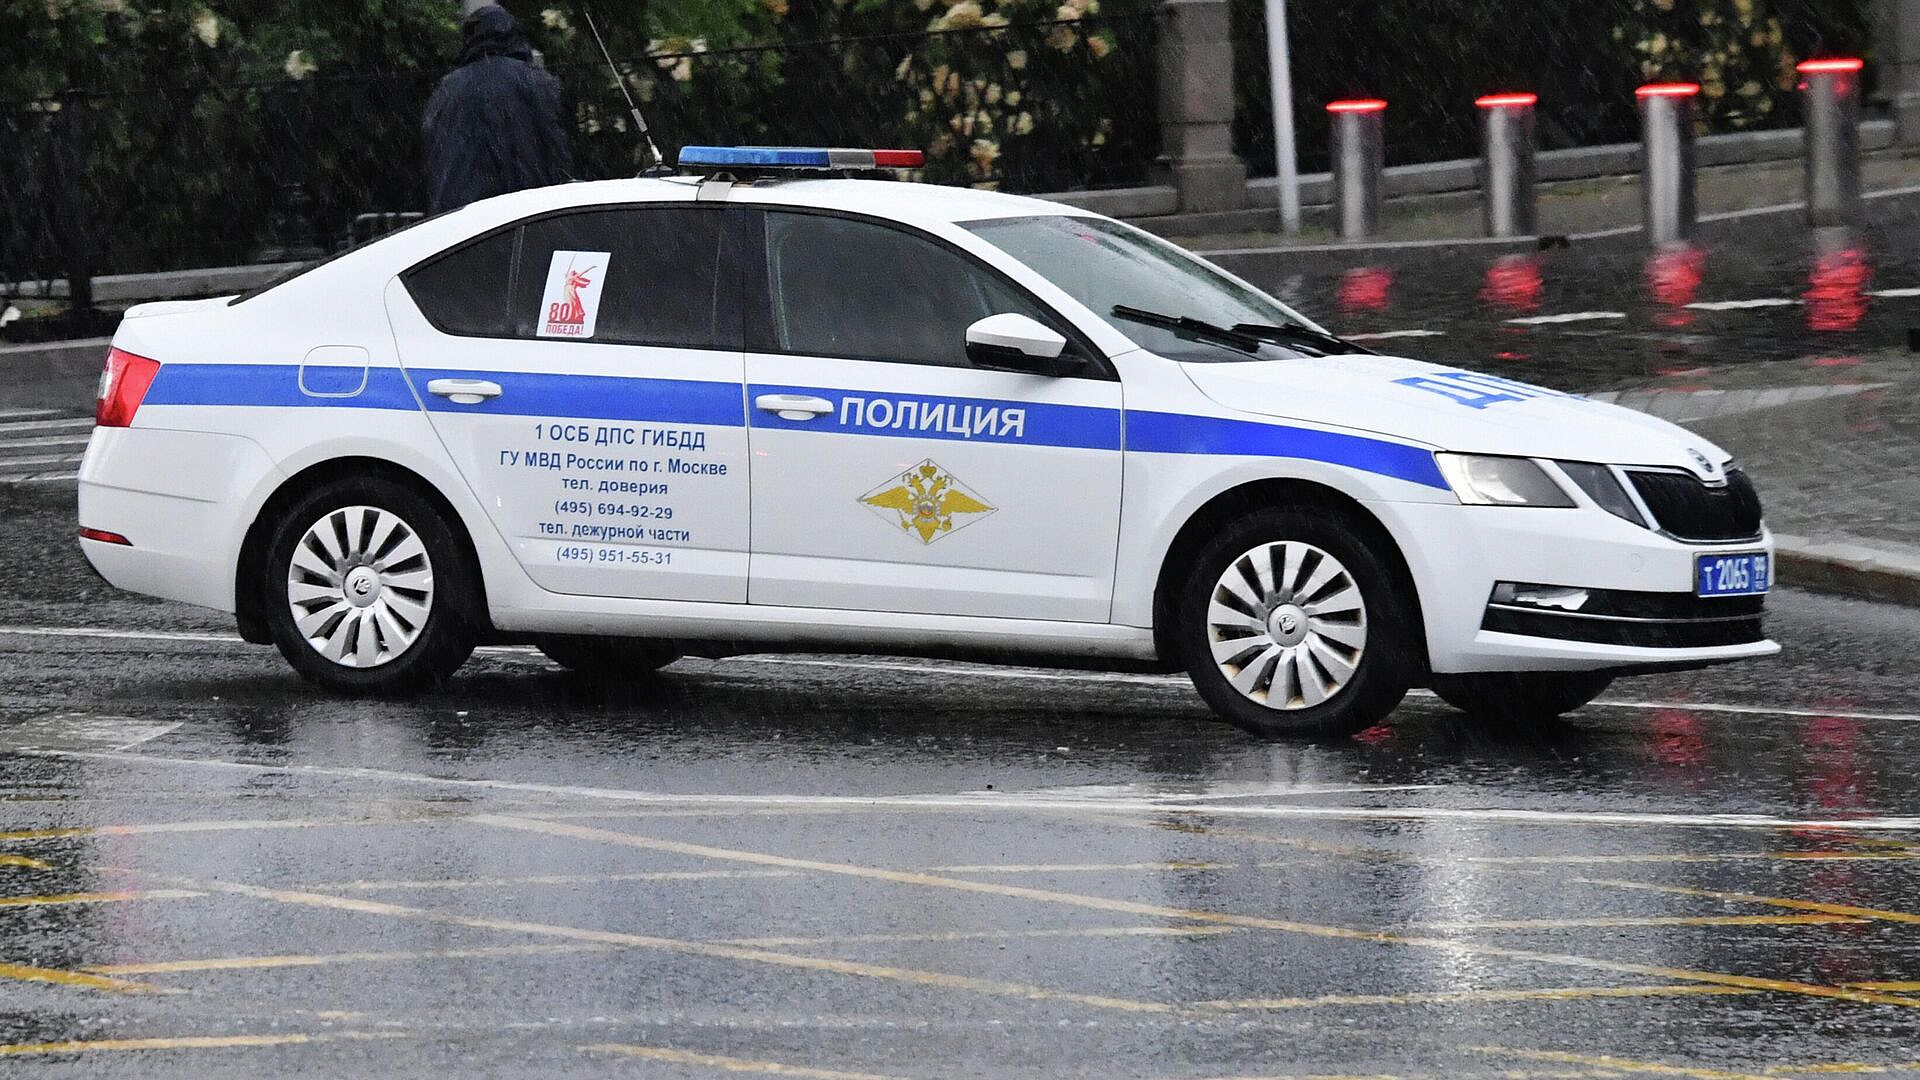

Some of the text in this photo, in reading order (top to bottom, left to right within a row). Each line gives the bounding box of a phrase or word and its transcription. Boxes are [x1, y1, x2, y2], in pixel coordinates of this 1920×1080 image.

[549, 303, 570, 320] 80
[545, 324, 584, 336] ПОБЕДА!
[1390, 372, 1590, 409] ДП
[840, 396, 1026, 438] ПОЛИЦИЯ
[535, 424, 706, 451] 1 ОСБ ДПС ГИБДД
[500, 451, 728, 475] ГУ МВД России по г. Москве
[562, 478, 668, 496] тел. доверия
[554, 501, 673, 520] (495) 694-92-29
[539, 522, 690, 542] тел. дежурной части
[556, 547, 673, 565] (495) 951-55-31
[1715, 558, 1749, 590] 2065
